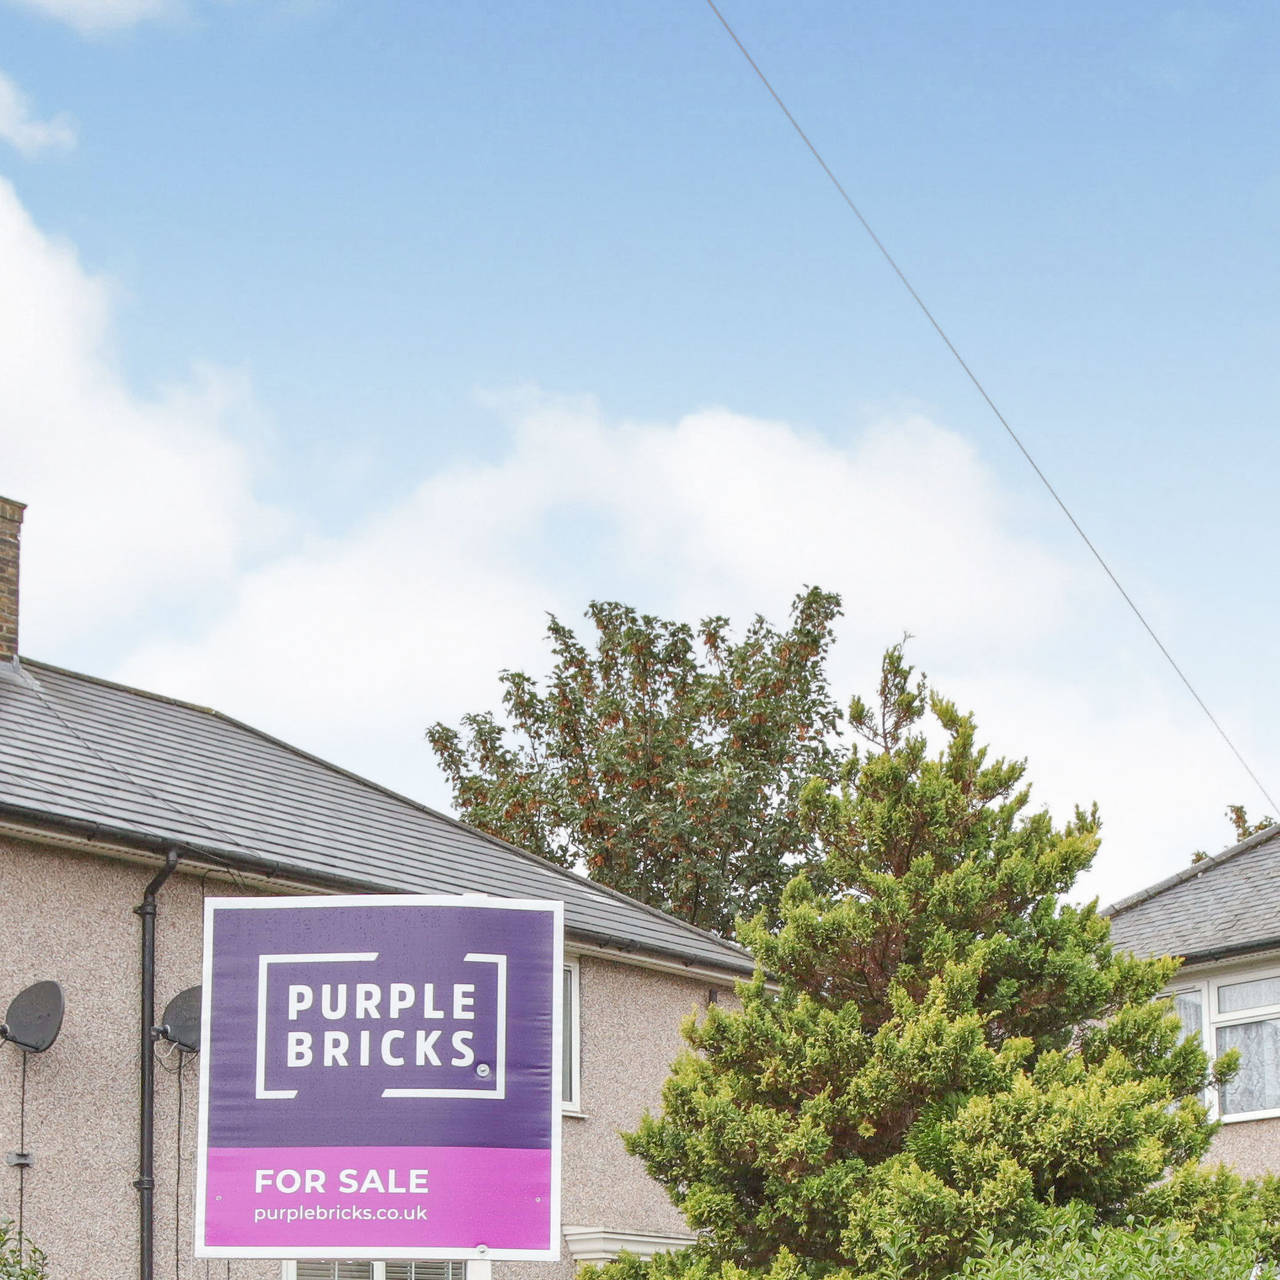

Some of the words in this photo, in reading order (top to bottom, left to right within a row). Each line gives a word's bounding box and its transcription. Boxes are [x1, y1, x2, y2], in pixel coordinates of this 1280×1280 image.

[288, 983, 476, 1020] PURPLE
[287, 1029, 476, 1068] BRICKS
[254, 1169, 326, 1193] FOR
[338, 1168, 430, 1194] SALE
[254, 1204, 428, 1224] purplebricks.co.uk
